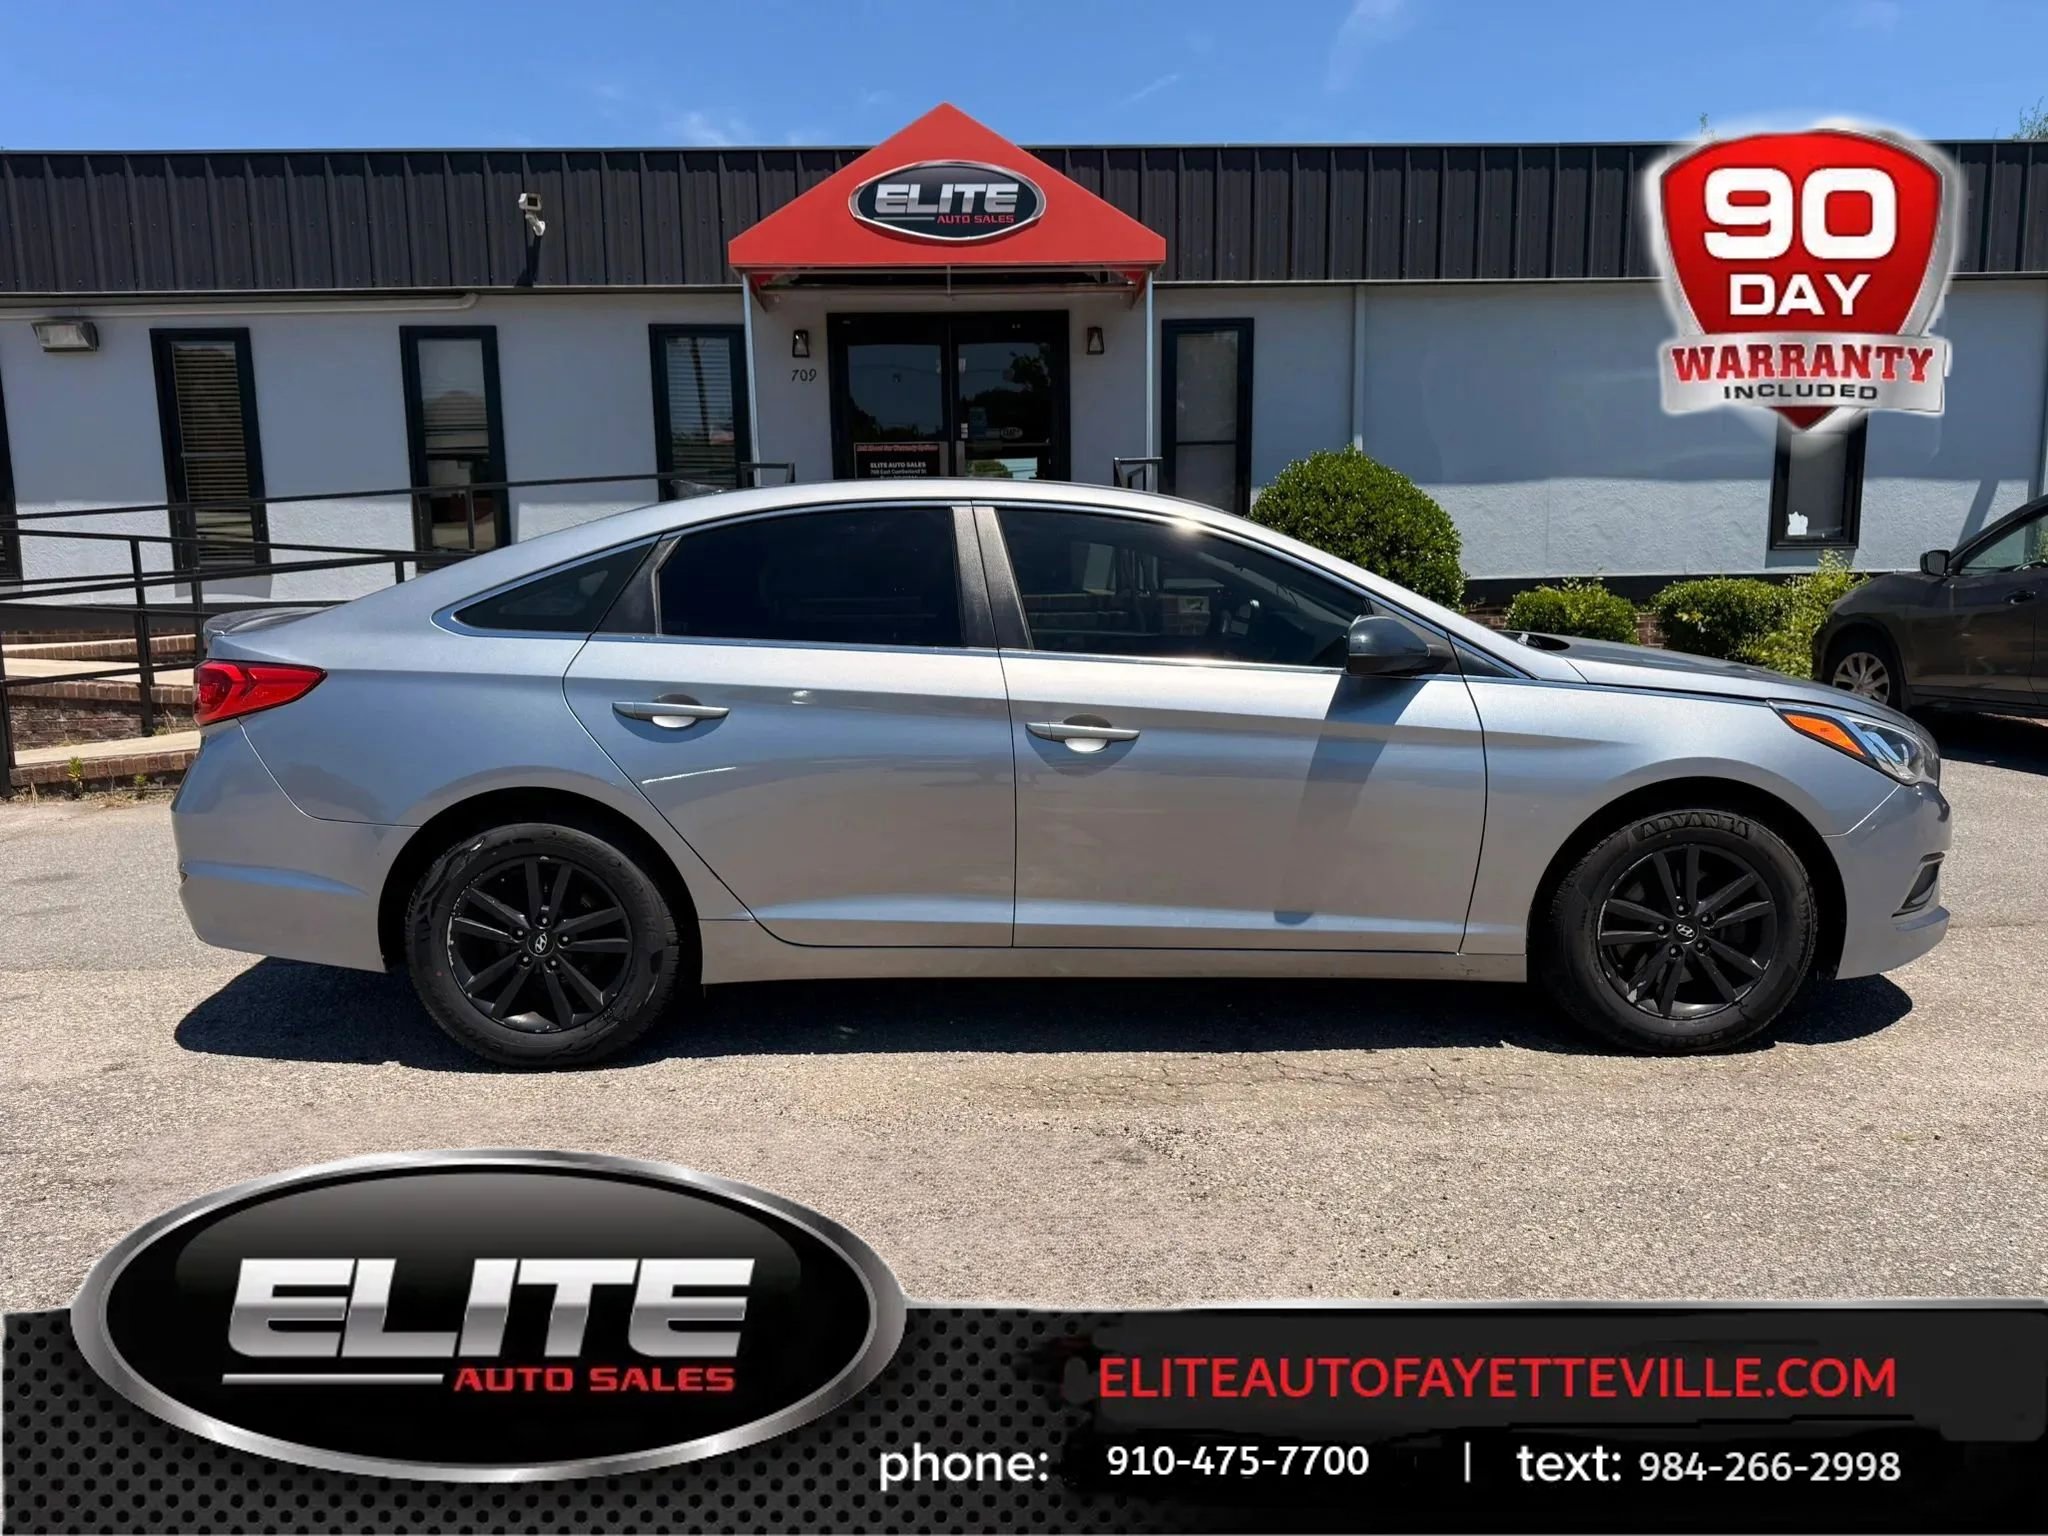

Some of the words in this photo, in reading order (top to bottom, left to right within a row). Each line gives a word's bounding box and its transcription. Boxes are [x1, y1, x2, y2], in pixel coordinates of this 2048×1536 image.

[874, 183, 1019, 214] ELITE
[937, 215, 971, 223] AUTO
[974, 214, 1015, 223] SALES
[791, 368, 817, 382] 709
